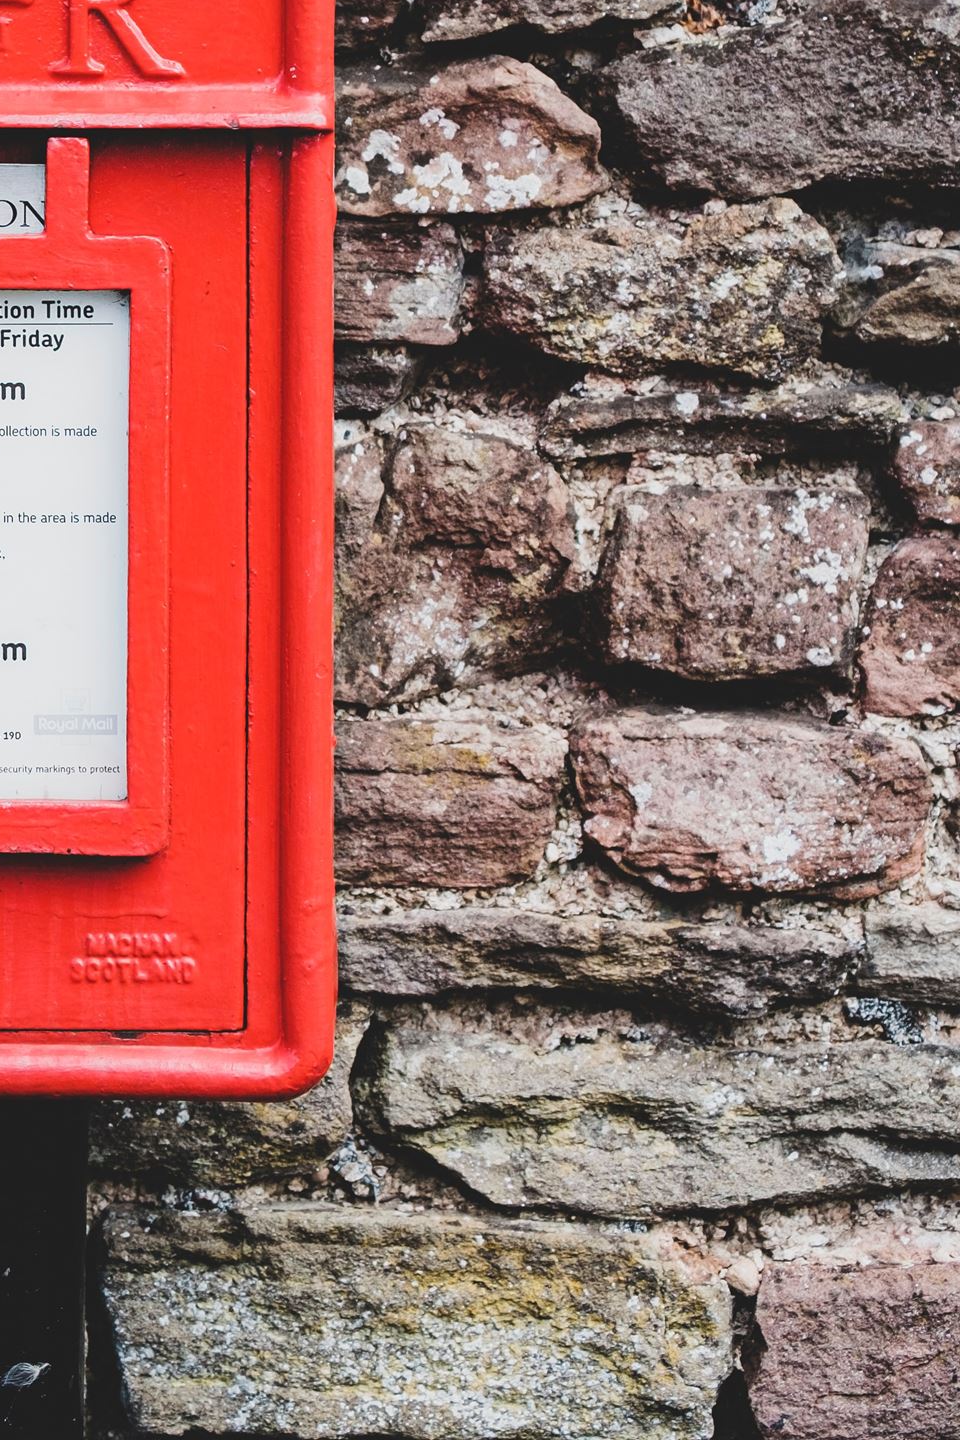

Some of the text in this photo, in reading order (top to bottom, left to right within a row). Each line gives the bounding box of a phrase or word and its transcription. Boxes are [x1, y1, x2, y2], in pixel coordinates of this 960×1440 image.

[42, 300, 94, 318] Time
[0, 329, 64, 351] Friday
[52, 425, 60, 436] is
[64, 425, 97, 437] made
[4, 512, 13, 523] in
[18, 512, 36, 523] the
[41, 515, 66, 523] area
[71, 512, 79, 523] is
[84, 512, 116, 523] made
[38, 716, 113, 733] Royal Mail
[0, 766, 32, 775] security
[36, 765, 75, 775] markings
[90, 766, 120, 774] protect
[70, 957, 197, 985] SCOTLAND
